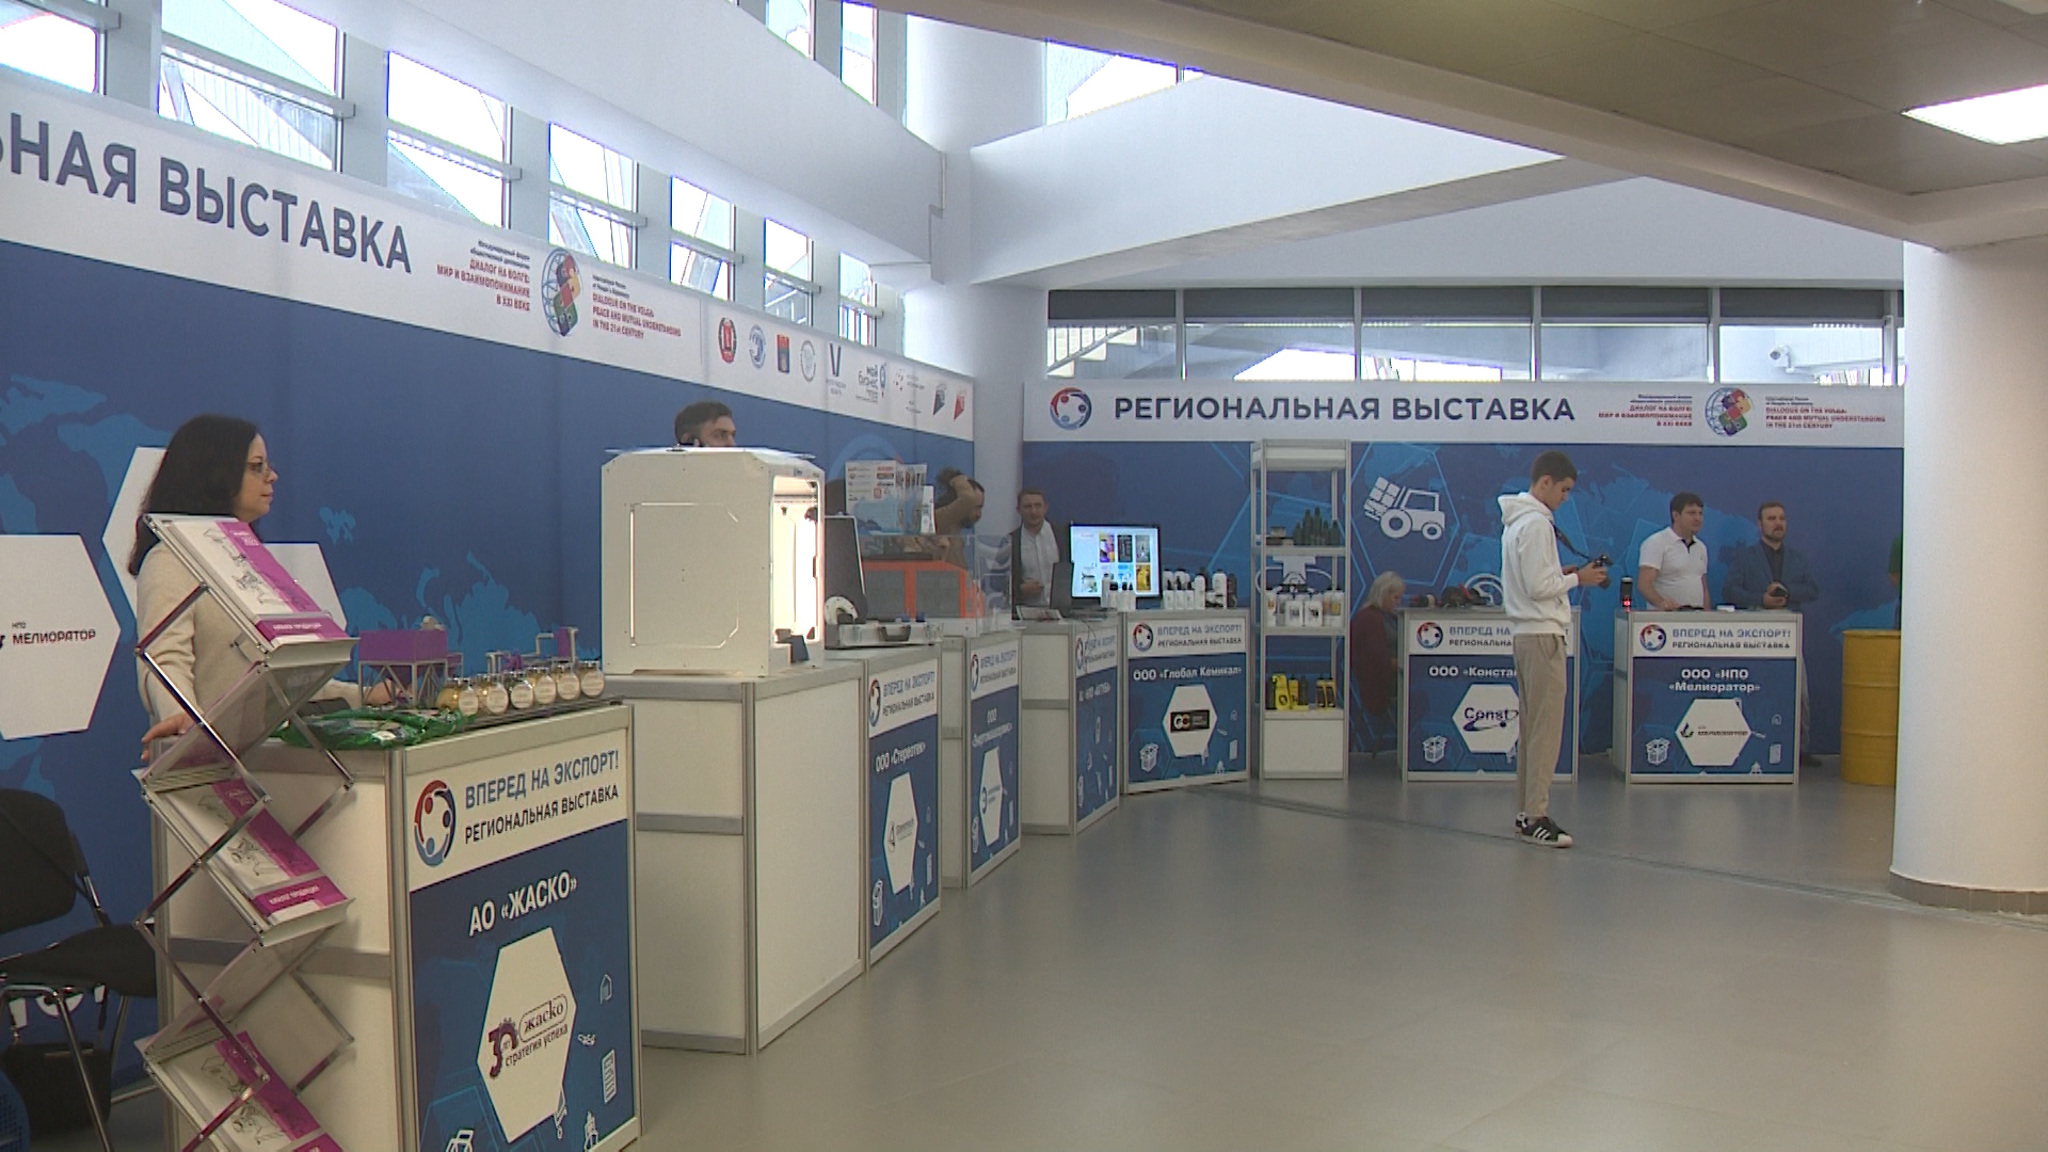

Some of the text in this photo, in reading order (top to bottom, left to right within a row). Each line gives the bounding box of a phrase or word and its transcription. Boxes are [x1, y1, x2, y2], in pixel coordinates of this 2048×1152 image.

[0, 112, 412, 274] НАЯ ВЫСТАВКА
[437, 264, 453, 276] МИР
[455, 268, 459, 279] И
[1115, 397, 1575, 421] РЕГИОНАЛЬНАЯ ВЫСТАВКА
[12, 629, 96, 644] МЕЛИОРАТОР
[1157, 626, 1190, 636] ВПЕРЕД
[1191, 626, 1202, 634] НА
[1449, 626, 1511, 637] ВПЕРЕД НА
[1672, 629, 1791, 638] ВПЕРЕД НА ЭКСПОРТ!
[1158, 638, 1208, 648] РЕГИОНАЛЬНАЯ
[1449, 639, 1513, 647] РЕГИОНАЛЬНА
[1672, 641, 1742, 649] РЕГИОНАЛЬНАЯ
[1133, 667, 1157, 681] ООО
[1429, 666, 1518, 677] ООО «Конста
[1681, 669, 1749, 680] ООО «НПО
[1669, 681, 1760, 694] «Мелиоратор»
[876, 752, 889, 773] ООО
[465, 749, 619, 810] ВПЕРЕД НА ЭКСПОРТ!
[465, 784, 619, 845] РЕГИОНАЛЬНАЯ ВЫСТАВКА
[469, 870, 578, 937] АО «ЖАСКО»
[505, 1035, 543, 1068] стратегия
[543, 1022, 569, 1049] успеха
